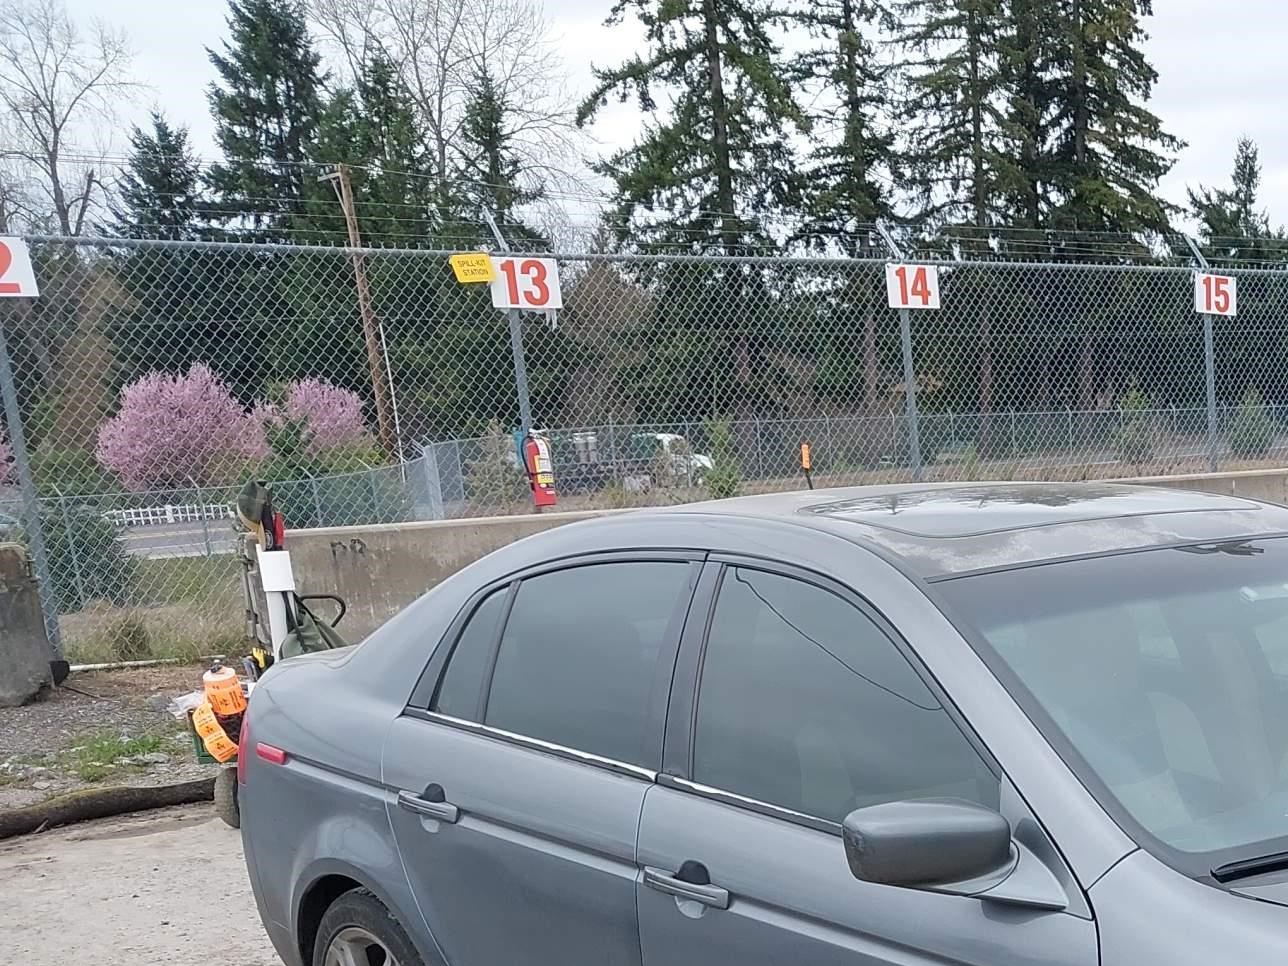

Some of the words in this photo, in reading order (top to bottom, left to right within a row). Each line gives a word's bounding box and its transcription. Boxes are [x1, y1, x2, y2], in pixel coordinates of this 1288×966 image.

[462, 268, 489, 276] STATION
[500, 260, 550, 305] 13
[895, 267, 931, 305] 14
[1203, 276, 1229, 312] 15
